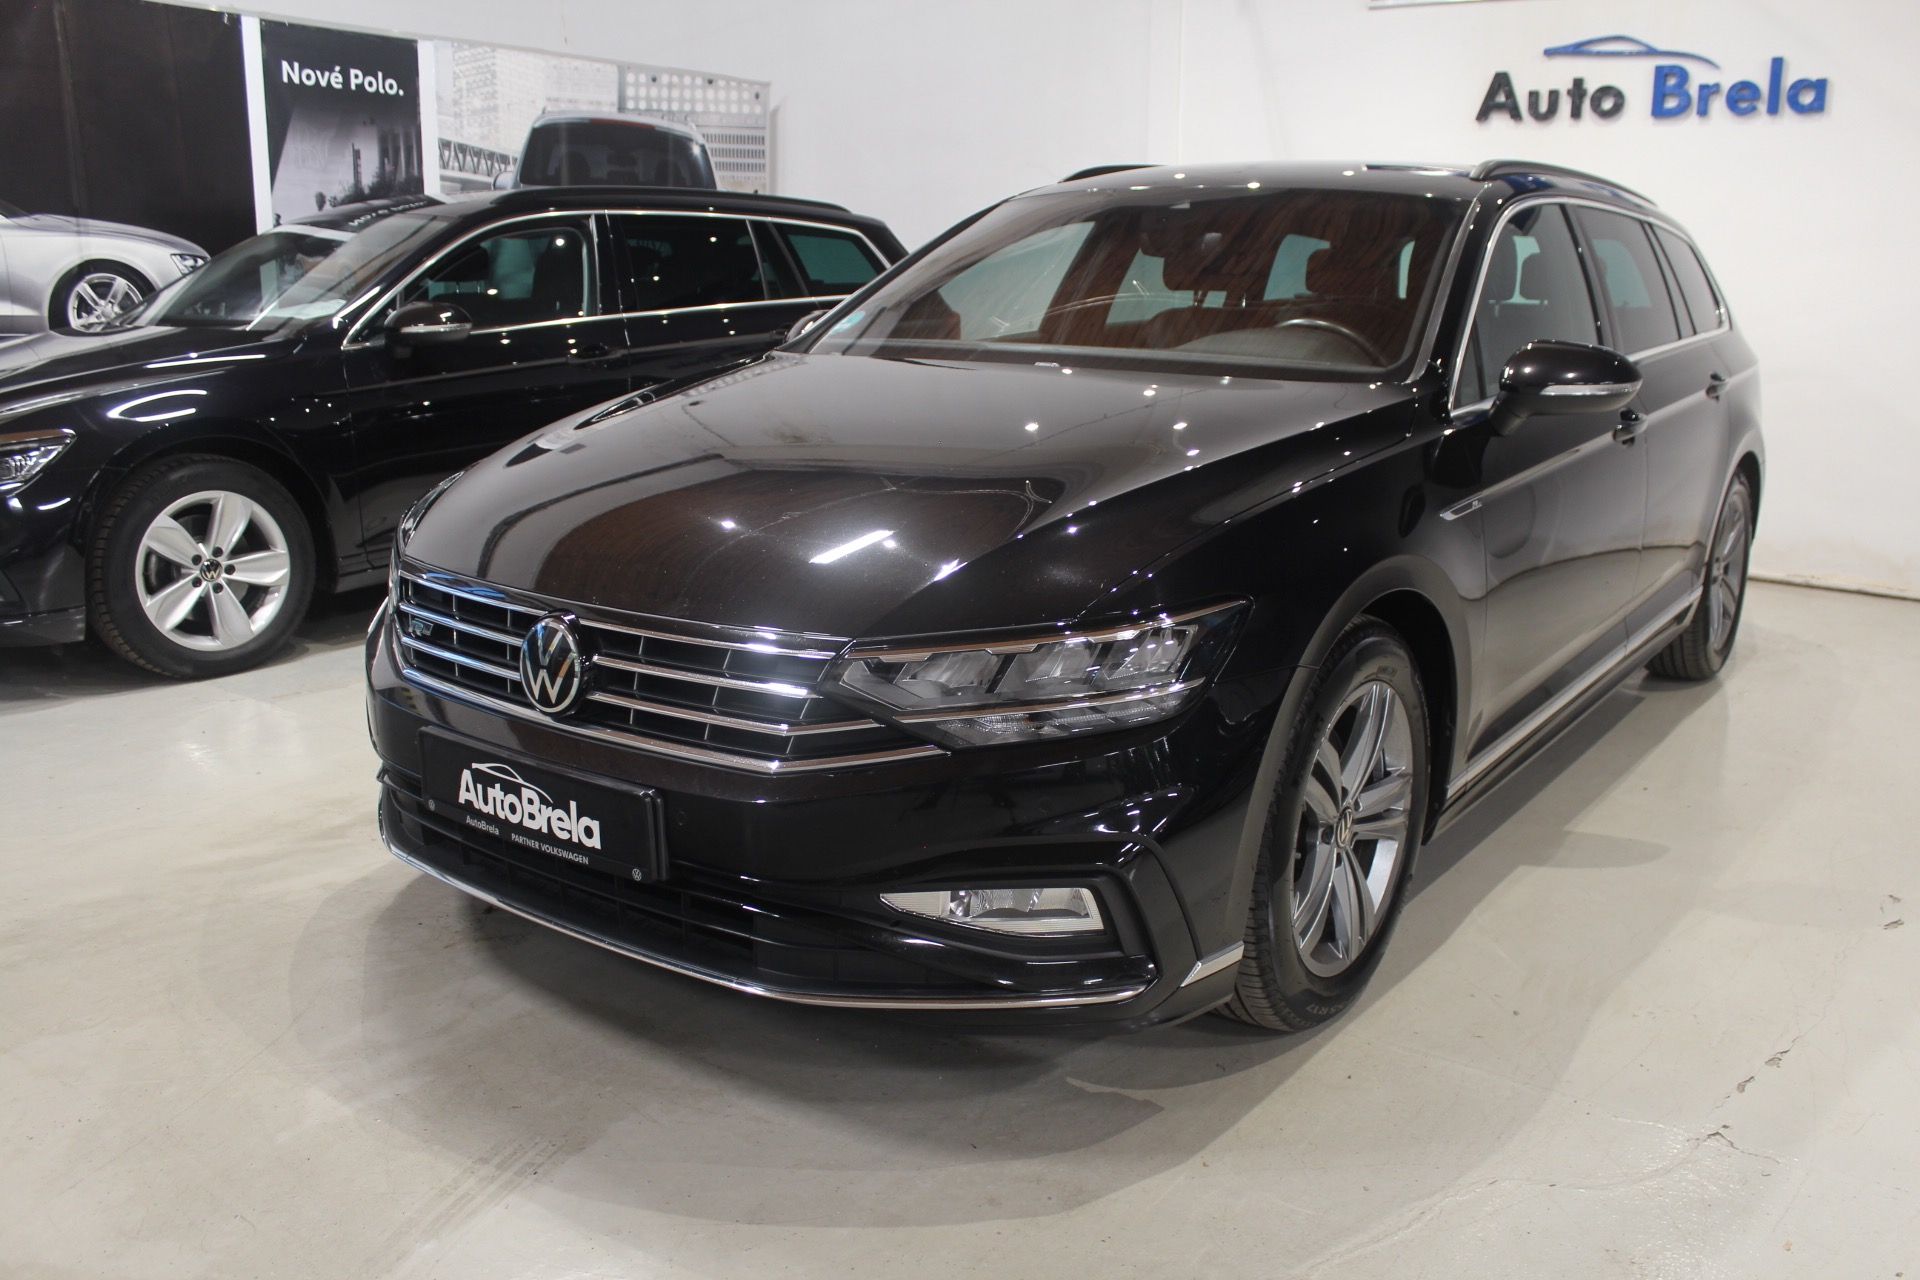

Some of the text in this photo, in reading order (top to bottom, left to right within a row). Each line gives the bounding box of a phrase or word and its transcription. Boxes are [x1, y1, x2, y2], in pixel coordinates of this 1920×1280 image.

[281, 59, 404, 97] Nové Polo.
[1475, 56, 1829, 122] Auto Brela
[458, 768, 602, 850] AutoBrela
[465, 815, 500, 836] AutoBrela
[511, 832, 589, 865] PARTNER VOLKSWAGEN
